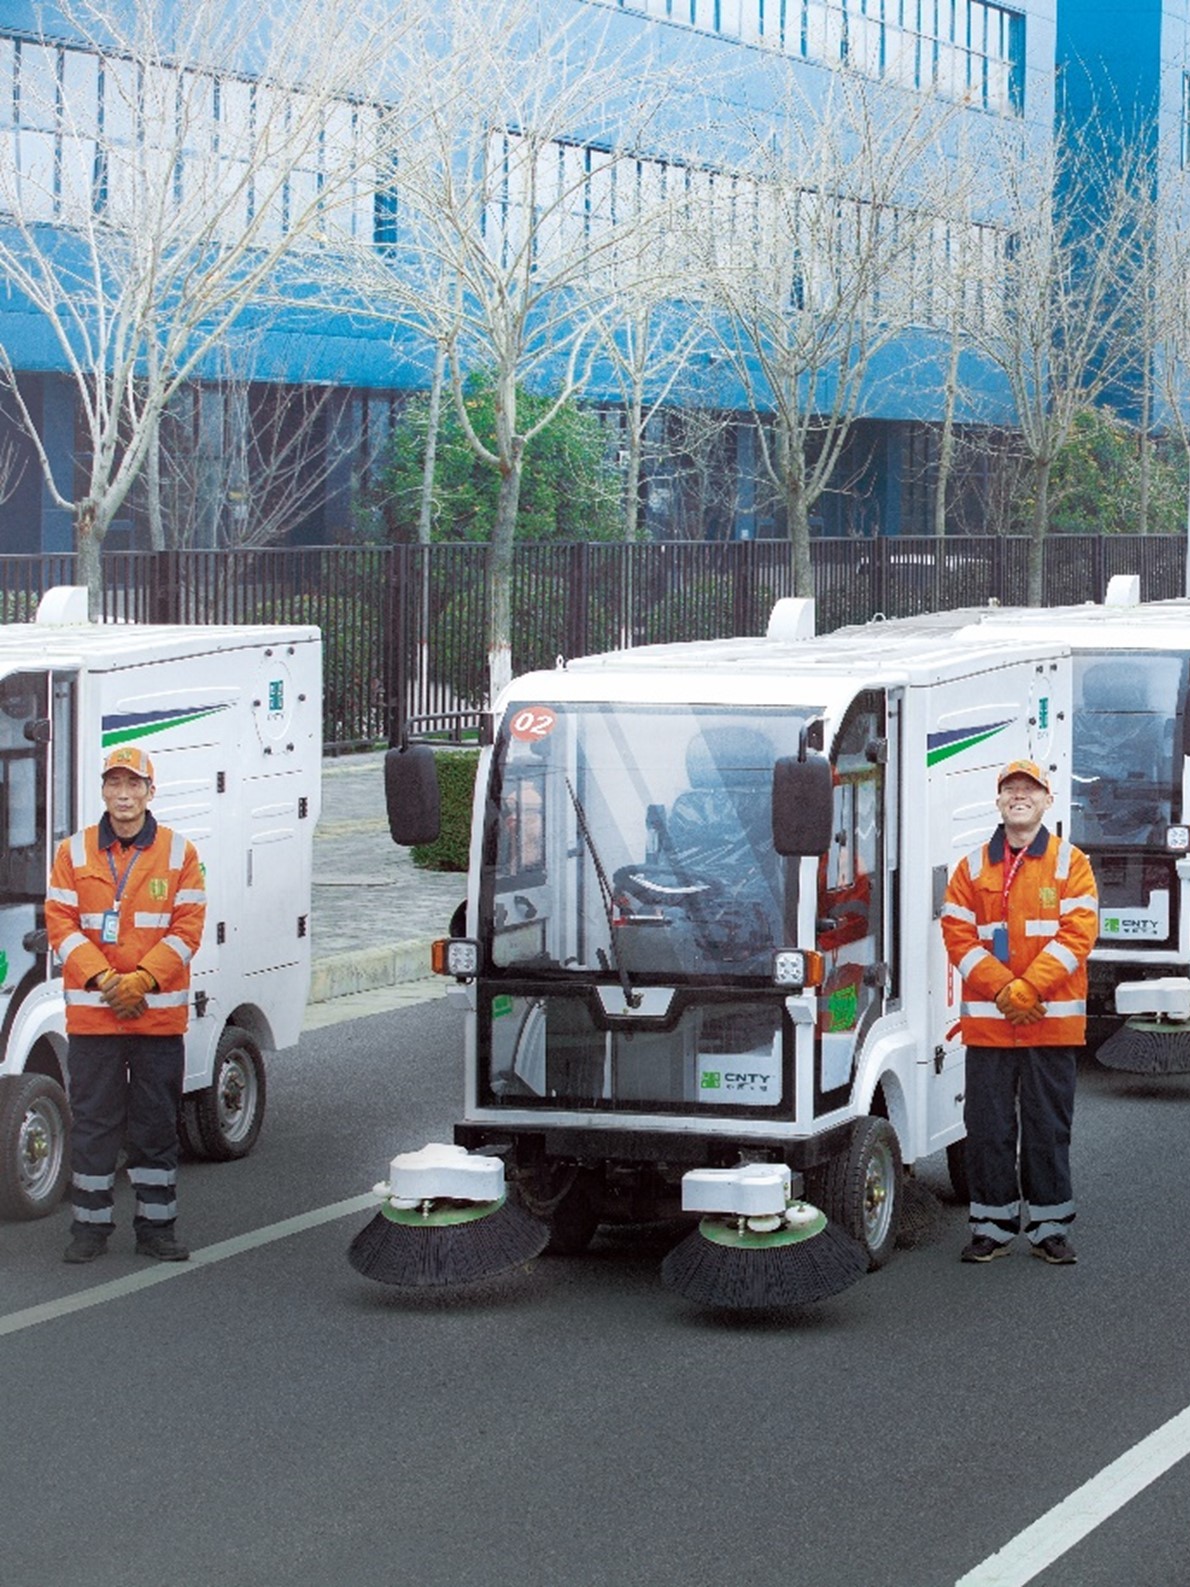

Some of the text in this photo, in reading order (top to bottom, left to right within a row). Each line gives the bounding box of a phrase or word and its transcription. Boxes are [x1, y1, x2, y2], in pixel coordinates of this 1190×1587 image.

[514, 712, 554, 736] 02
[1122, 919, 1158, 928] CNTY
[724, 1072, 771, 1083] CNTY
